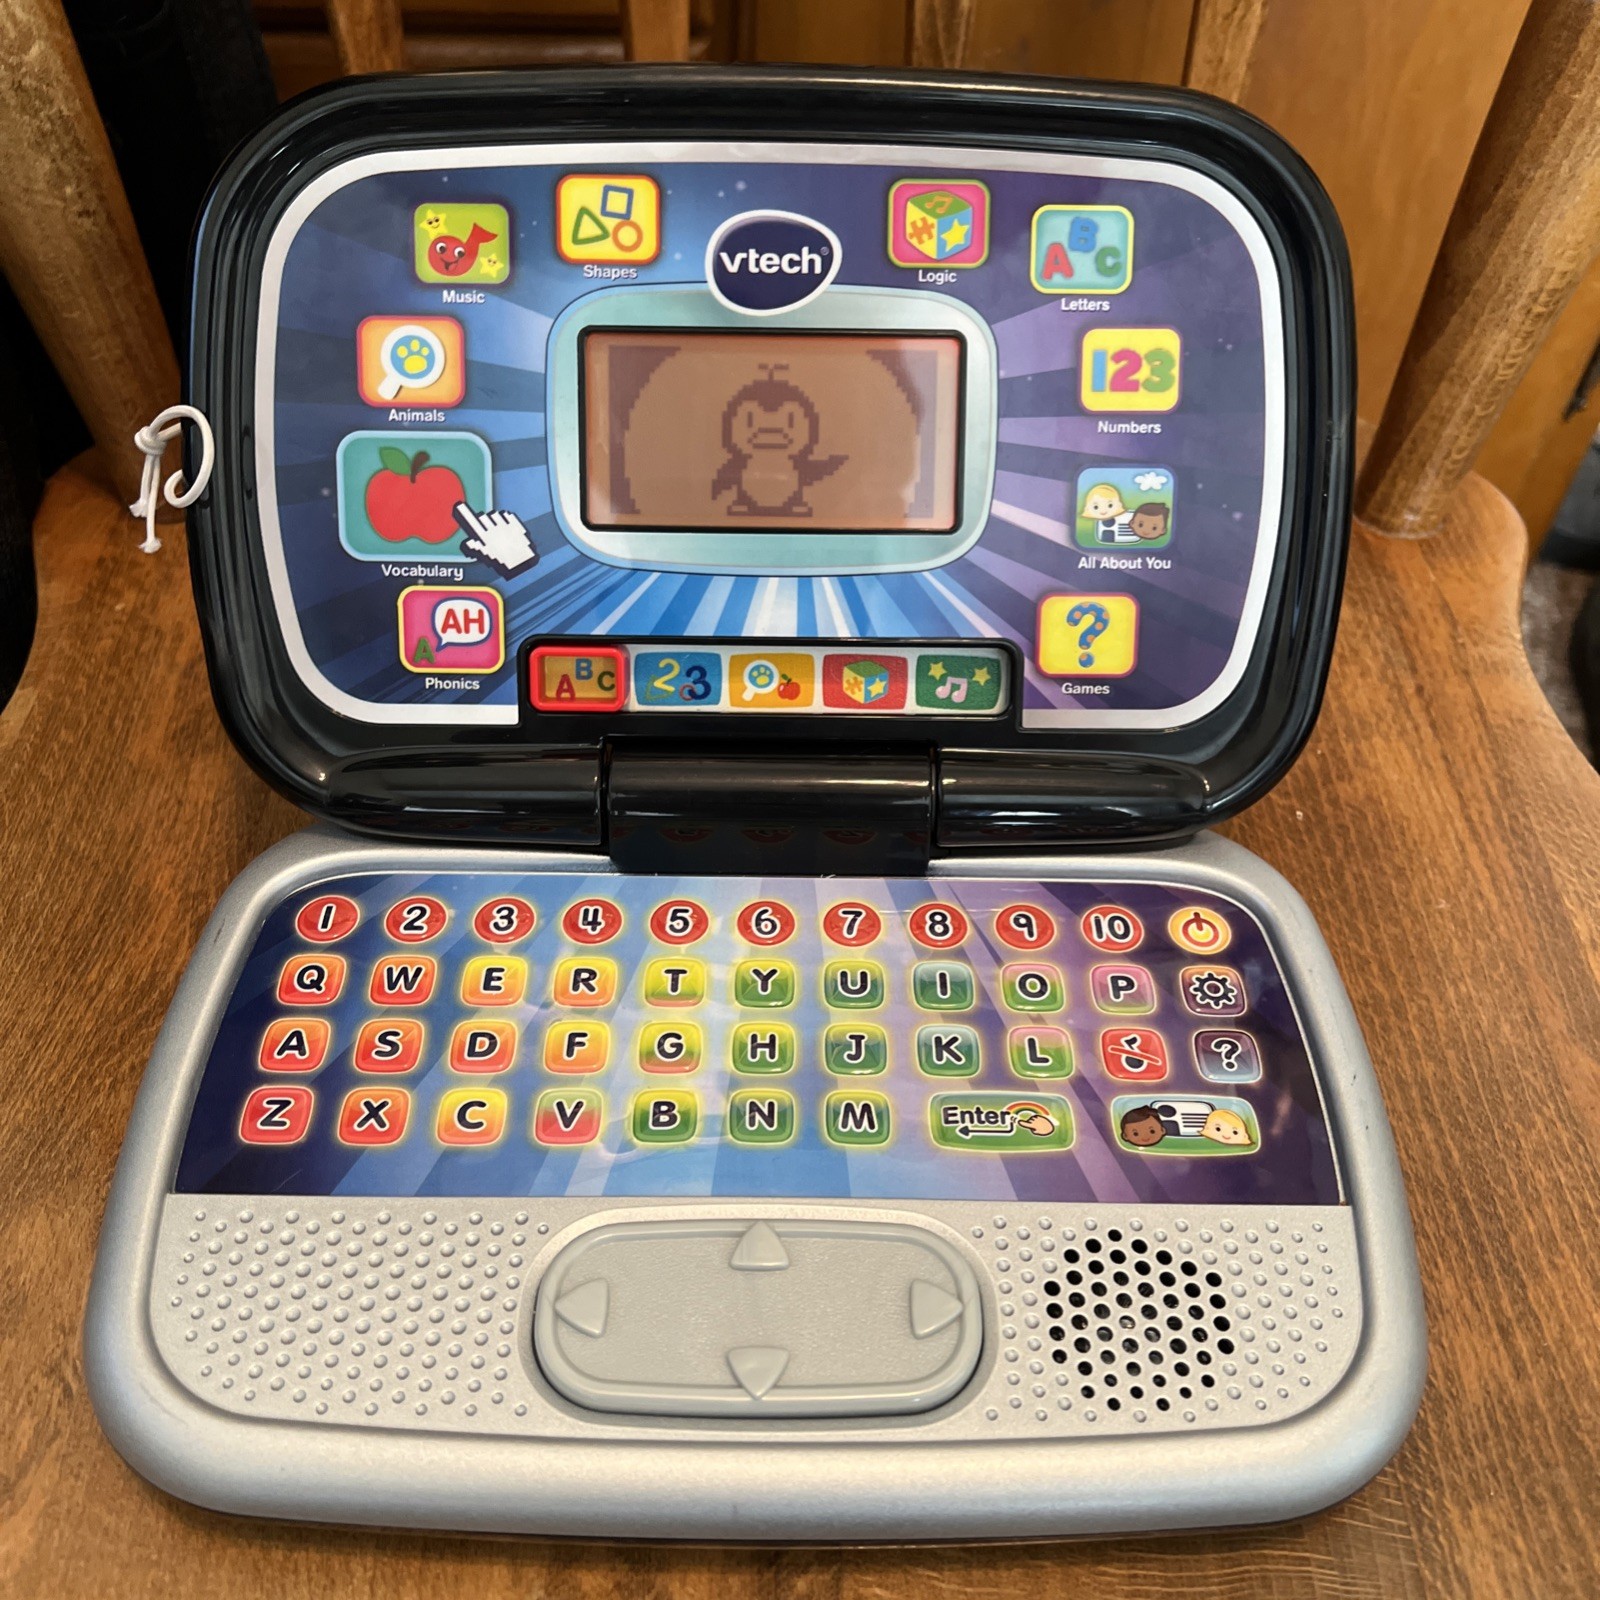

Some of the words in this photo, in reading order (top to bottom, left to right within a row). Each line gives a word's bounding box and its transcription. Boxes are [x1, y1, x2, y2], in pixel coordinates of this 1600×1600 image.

[719, 245, 822, 276] vtech
[583, 264, 638, 281] Shapes
[918, 269, 957, 285] Logic
[441, 289, 486, 305] Music
[1060, 297, 1111, 312] Letters
[1091, 348, 1176, 394] 123
[388, 408, 446, 423] Animals
[1097, 420, 1162, 435] Numbers
[1077, 556, 1097, 570] All
[1099, 556, 1143, 570] About
[1145, 556, 1172, 570] You
[381, 563, 464, 582] Vocabulary
[440, 607, 486, 636] AH
[413, 637, 436, 664] A
[424, 676, 481, 692] Phonics
[1061, 682, 1111, 696] Games
[402, 904, 429, 932] 2
[492, 905, 516, 933] 3
[580, 906, 604, 933] 4
[668, 907, 691, 935] 5
[754, 907, 779, 936] 6
[841, 909, 864, 938] 7
[927, 910, 951, 939] 8
[1011, 912, 1036, 940] 9
[1092, 913, 1132, 942] 10
[295, 964, 327, 993] Q
[384, 965, 424, 992] W
[481, 966, 507, 993] E
[570, 967, 598, 994] R
[662, 968, 689, 995] T
[750, 967, 779, 994] Y
[839, 969, 870, 997] U
[1016, 971, 1050, 1000] O
[1109, 974, 1137, 1001] P
[275, 1028, 308, 1058] A
[373, 1029, 402, 1059] S
[465, 1030, 499, 1059] D
[565, 1031, 589, 1060] F
[656, 1031, 685, 1061] G
[748, 1032, 778, 1061] H
[844, 1033, 867, 1063] J
[933, 1034, 965, 1066] K
[1026, 1036, 1051, 1066] L
[258, 1098, 293, 1128] Z
[355, 1099, 391, 1131] X
[455, 1099, 488, 1130] C
[553, 1099, 585, 1130] V
[650, 1100, 679, 1129] B
[746, 1100, 776, 1130] N
[840, 1101, 878, 1132] M
[942, 1105, 1013, 1126] Enter
